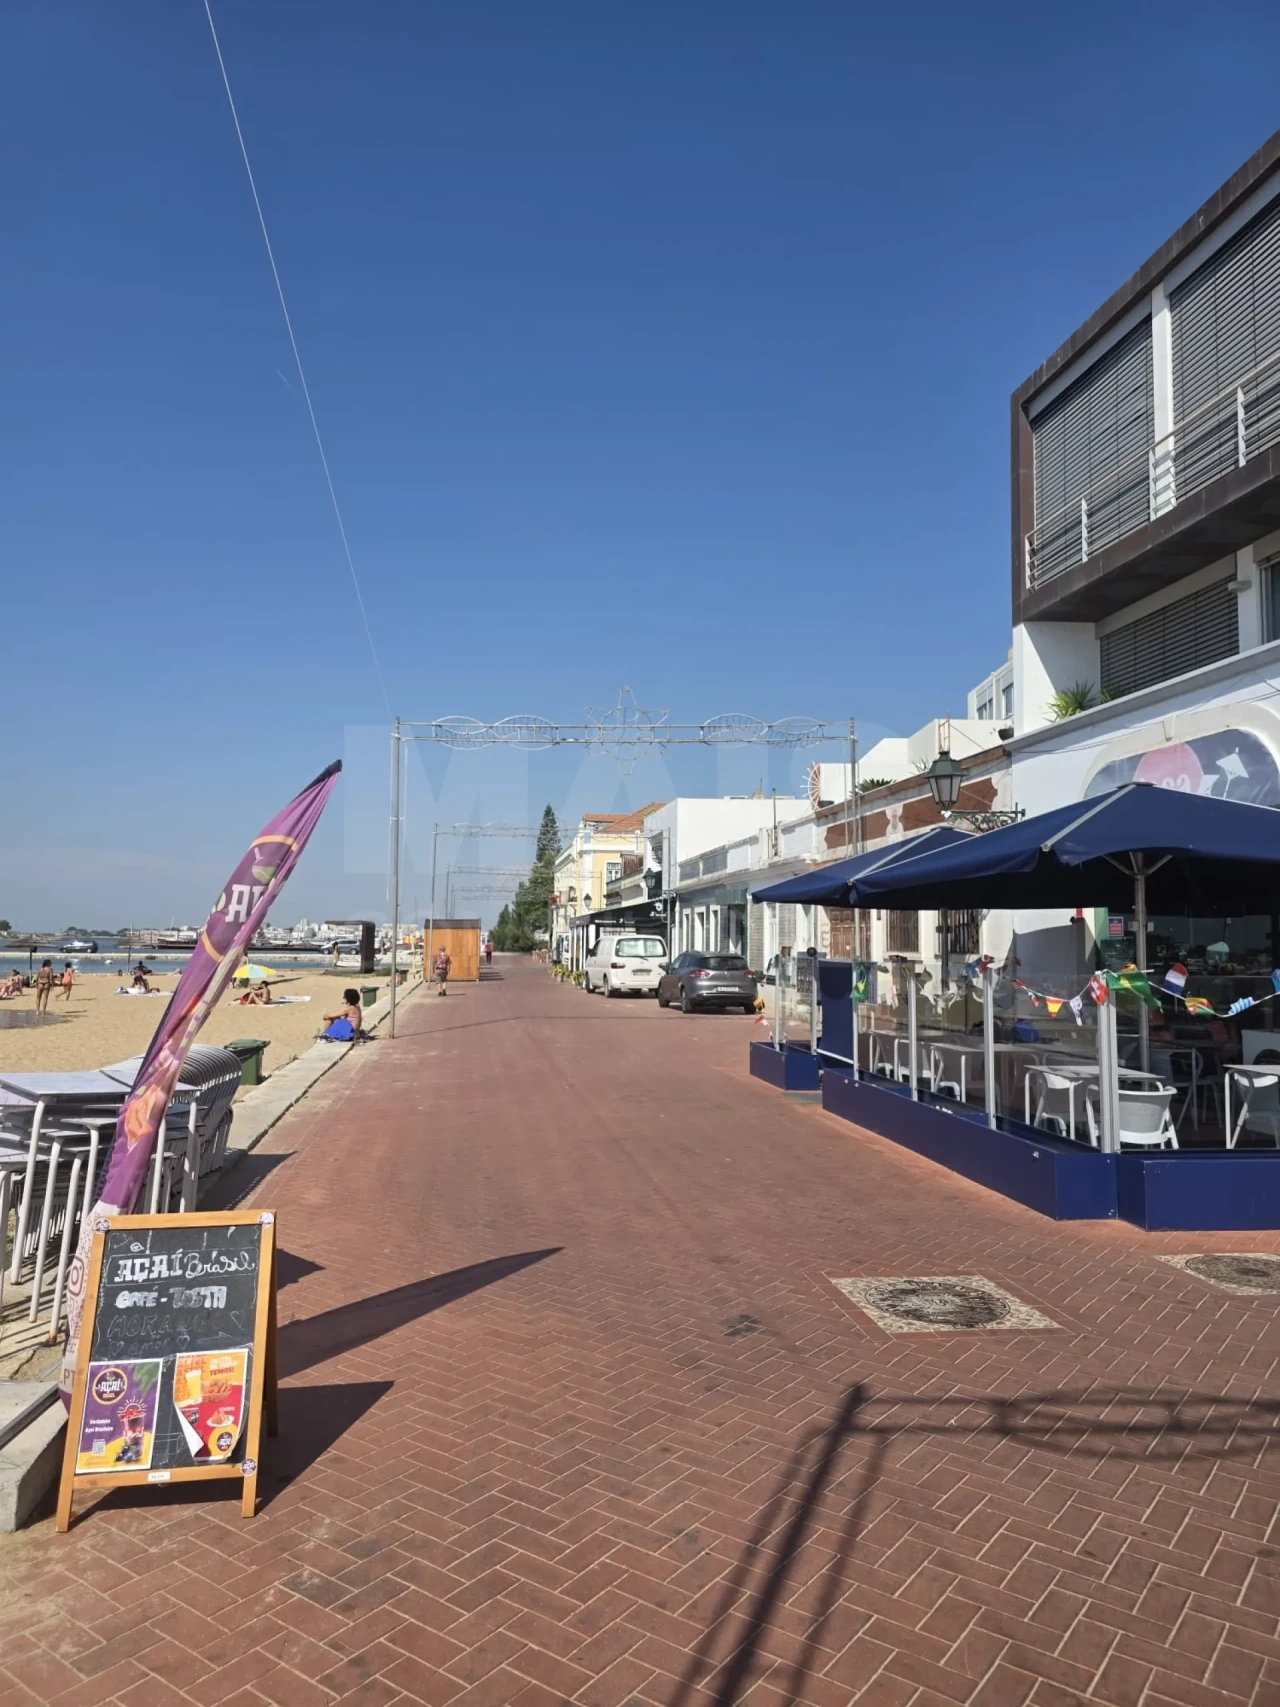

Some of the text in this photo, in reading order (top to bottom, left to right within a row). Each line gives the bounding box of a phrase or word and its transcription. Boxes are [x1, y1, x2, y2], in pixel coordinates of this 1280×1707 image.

[114, 1248, 184, 1282] AÇAÍ
[114, 1285, 158, 1309] CAFÉ
[100, 1378, 121, 1393] AÇAÍ
